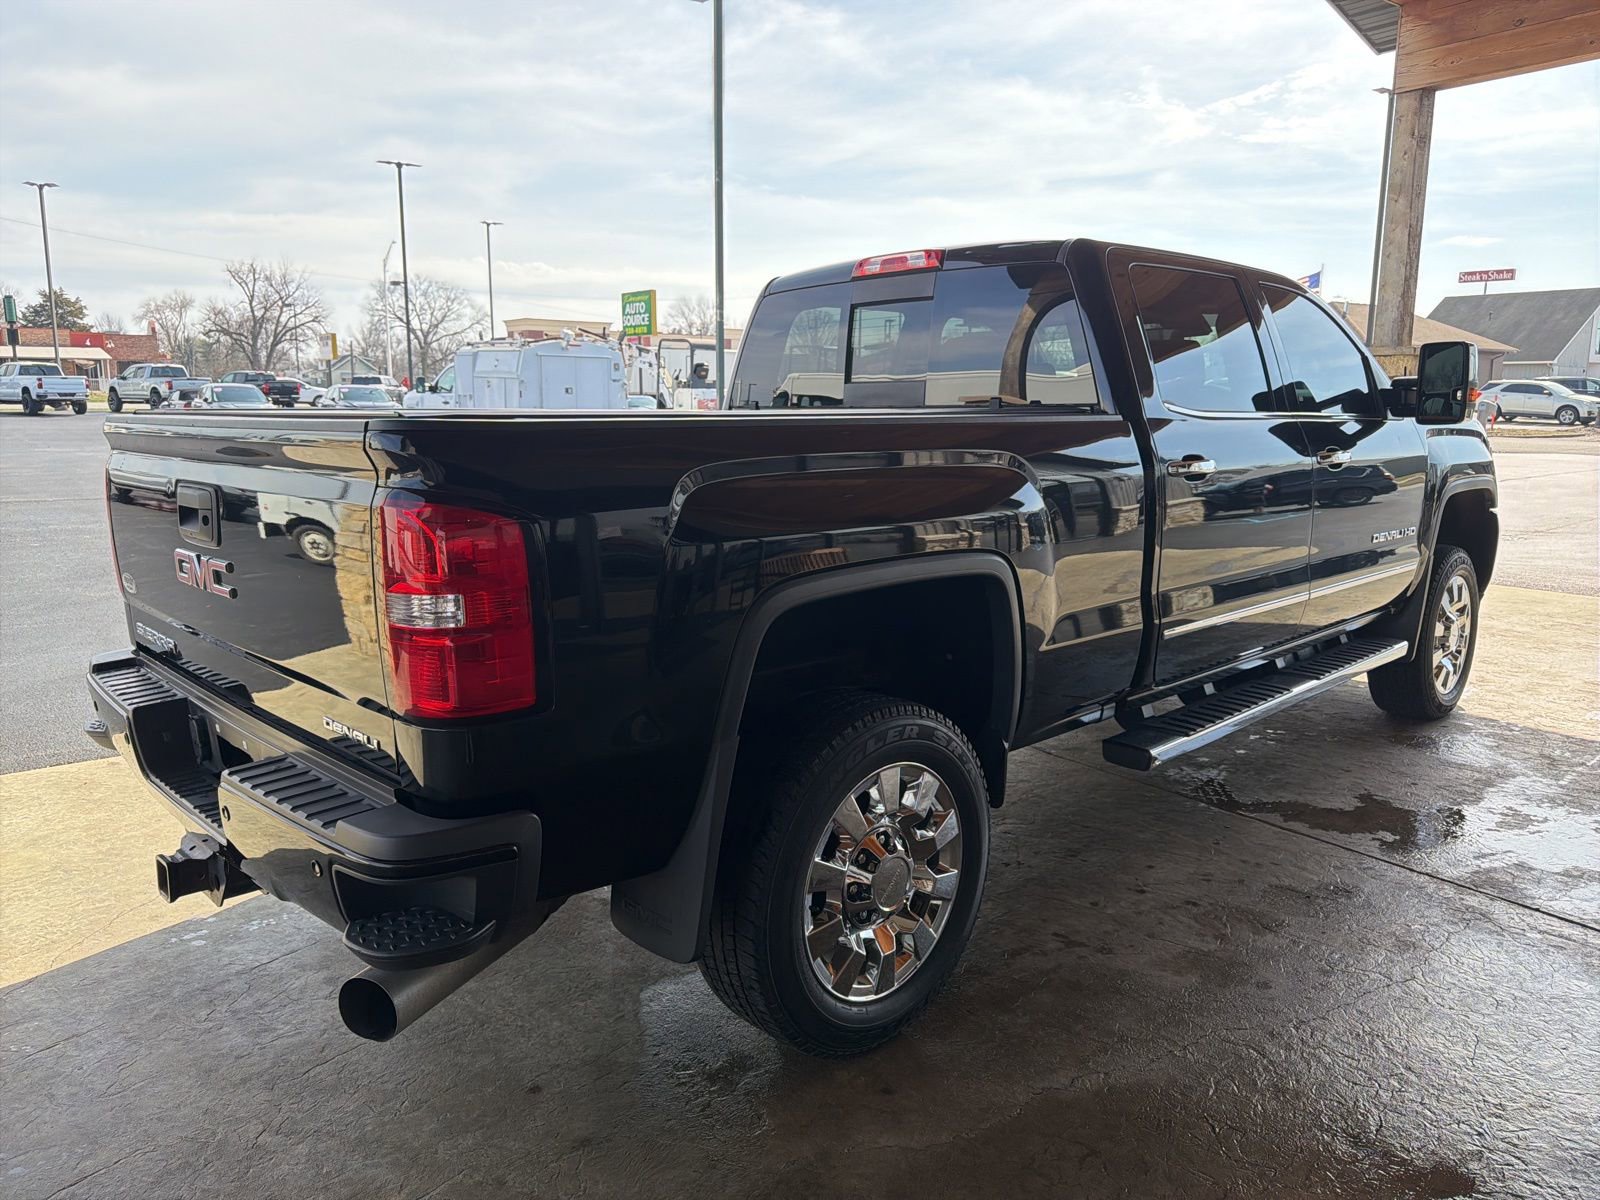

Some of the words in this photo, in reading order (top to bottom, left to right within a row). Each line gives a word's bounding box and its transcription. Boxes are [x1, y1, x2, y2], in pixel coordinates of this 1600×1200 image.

[1488, 270, 1512, 280] Shake
[625, 301, 646, 315] AUTO
[623, 313, 650, 327] SOURCE
[1371, 528, 1404, 543] DENALI
[1404, 526, 1417, 537] HD
[174, 548, 238, 599] GMC
[323, 716, 380, 752] DENALI
